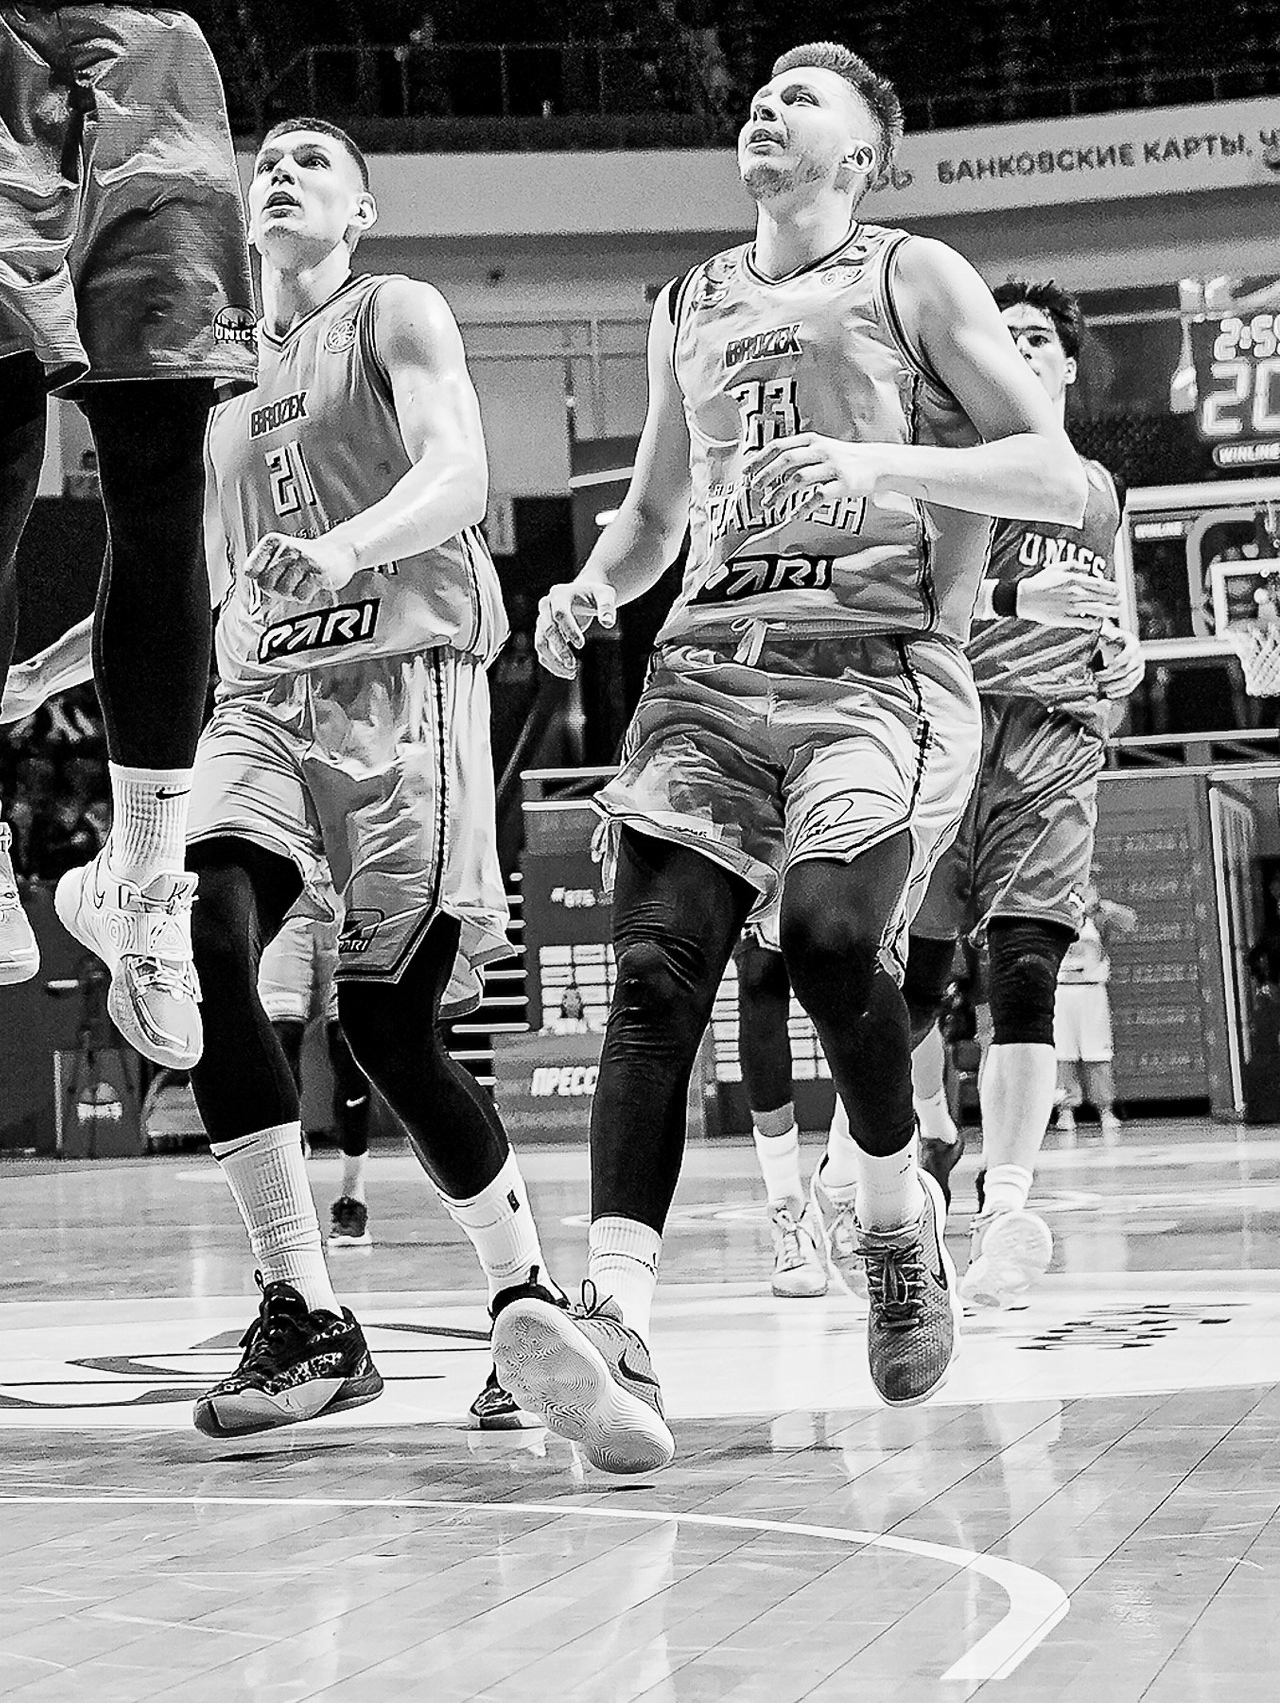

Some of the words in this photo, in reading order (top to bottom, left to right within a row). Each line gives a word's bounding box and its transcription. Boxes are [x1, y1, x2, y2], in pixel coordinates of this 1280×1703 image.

[937, 143, 1135, 184] БАНКОВСКИЕ
[215, 323, 259, 342] UNICS
[726, 324, 801, 367] BROZEX
[251, 391, 308, 439] BROZEX
[265, 440, 317, 517] 21
[258, 604, 374, 660] PARI
